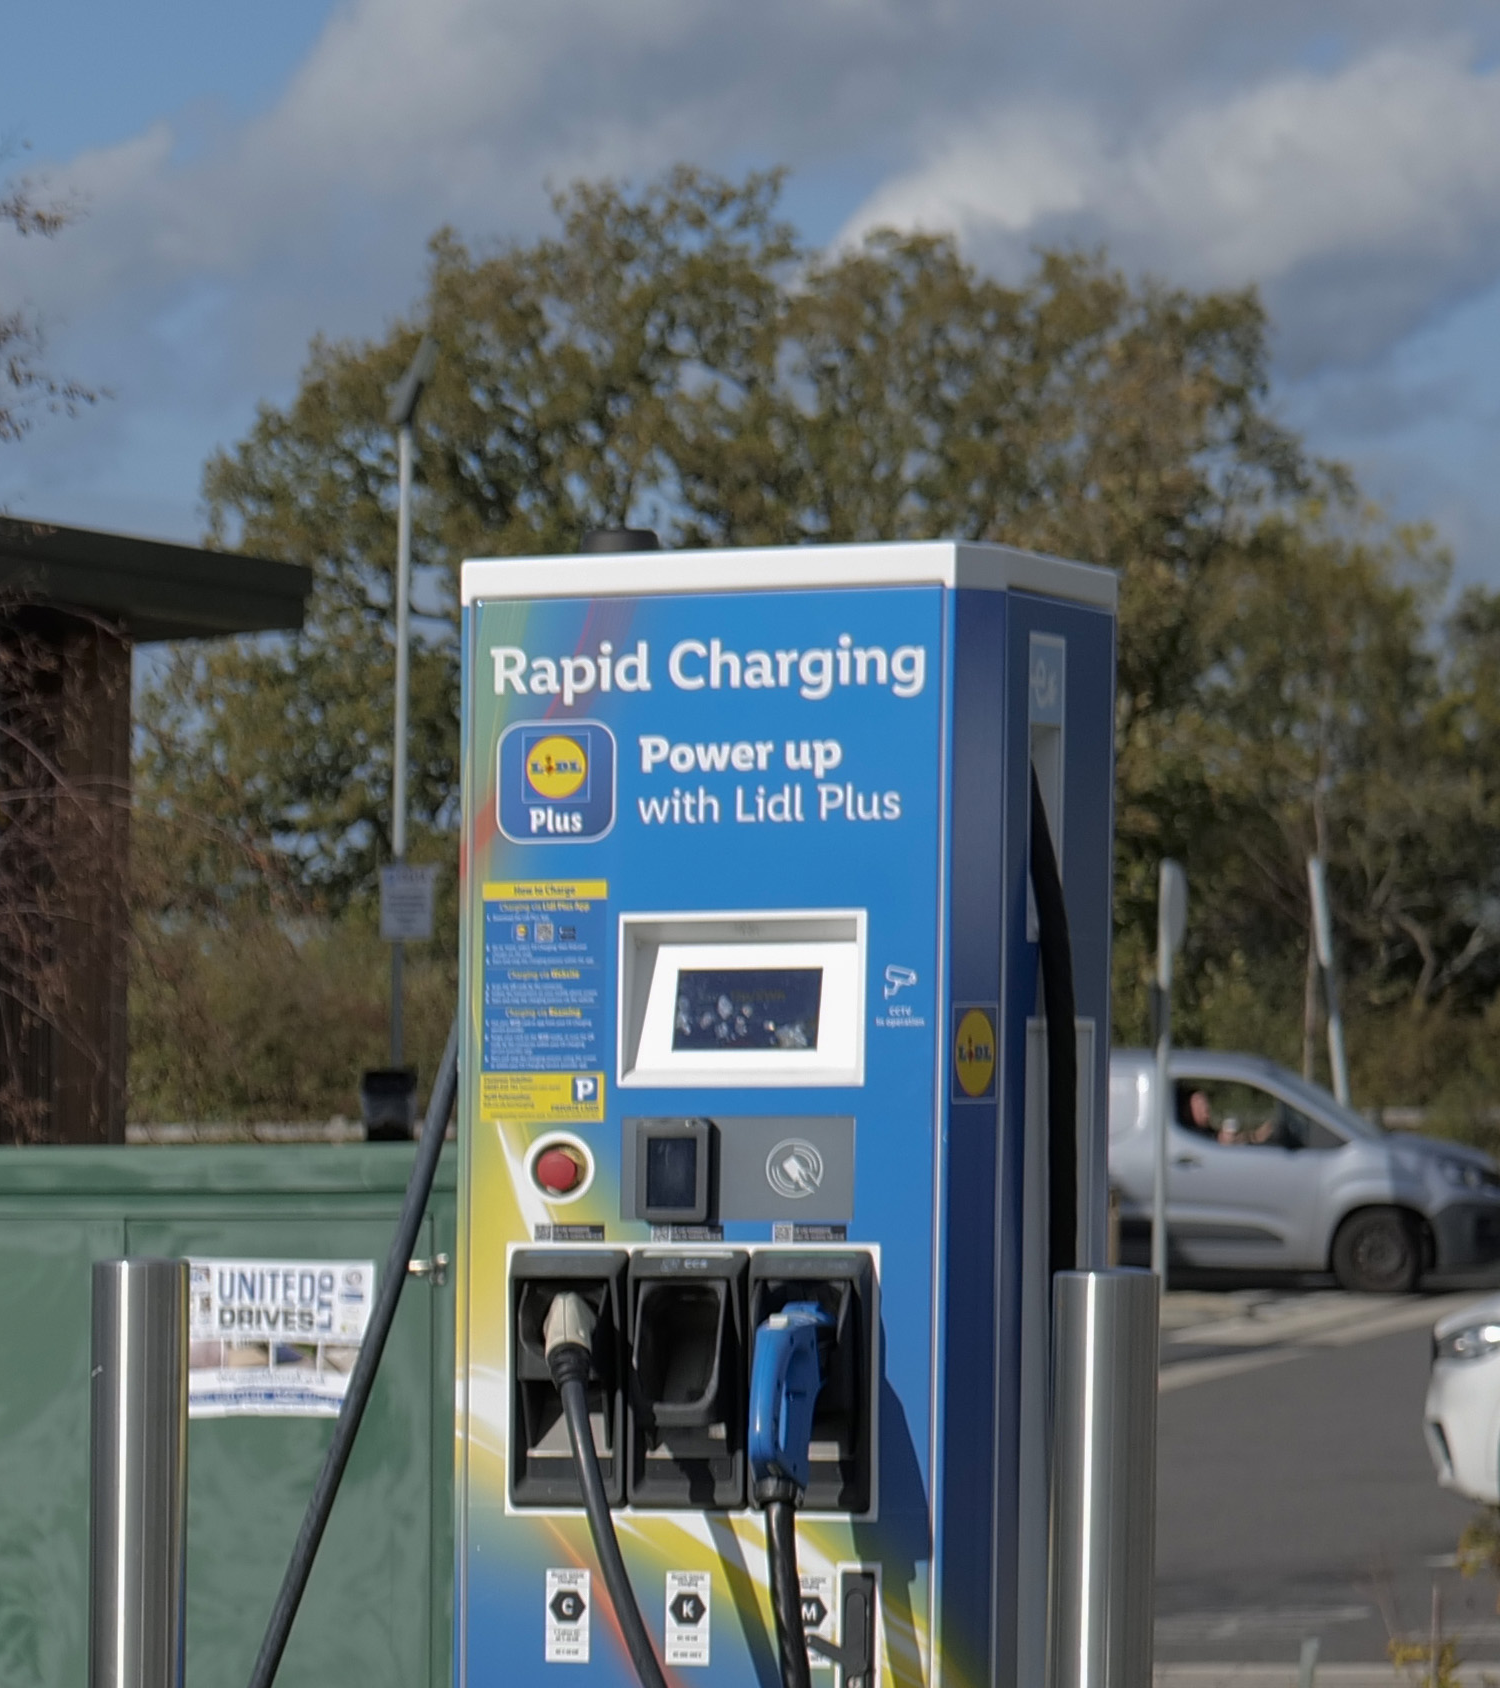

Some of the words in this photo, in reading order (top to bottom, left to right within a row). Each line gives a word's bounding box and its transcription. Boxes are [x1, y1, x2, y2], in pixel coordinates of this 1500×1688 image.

[489, 640, 652, 706] Rapid
[668, 633, 927, 701] Charging
[639, 735, 775, 774] Power
[785, 740, 842, 779] up
[529, 805, 583, 834] Plus
[638, 786, 720, 825] with
[735, 784, 805, 823] Lidl
[817, 781, 902, 822] Plus
[217, 1268, 315, 1305] UNITED
[316, 1271, 334, 1333] LTD
[218, 1308, 314, 1332] DRIVES
[682, 1599, 694, 1618] K
[802, 1603, 817, 1621] M
